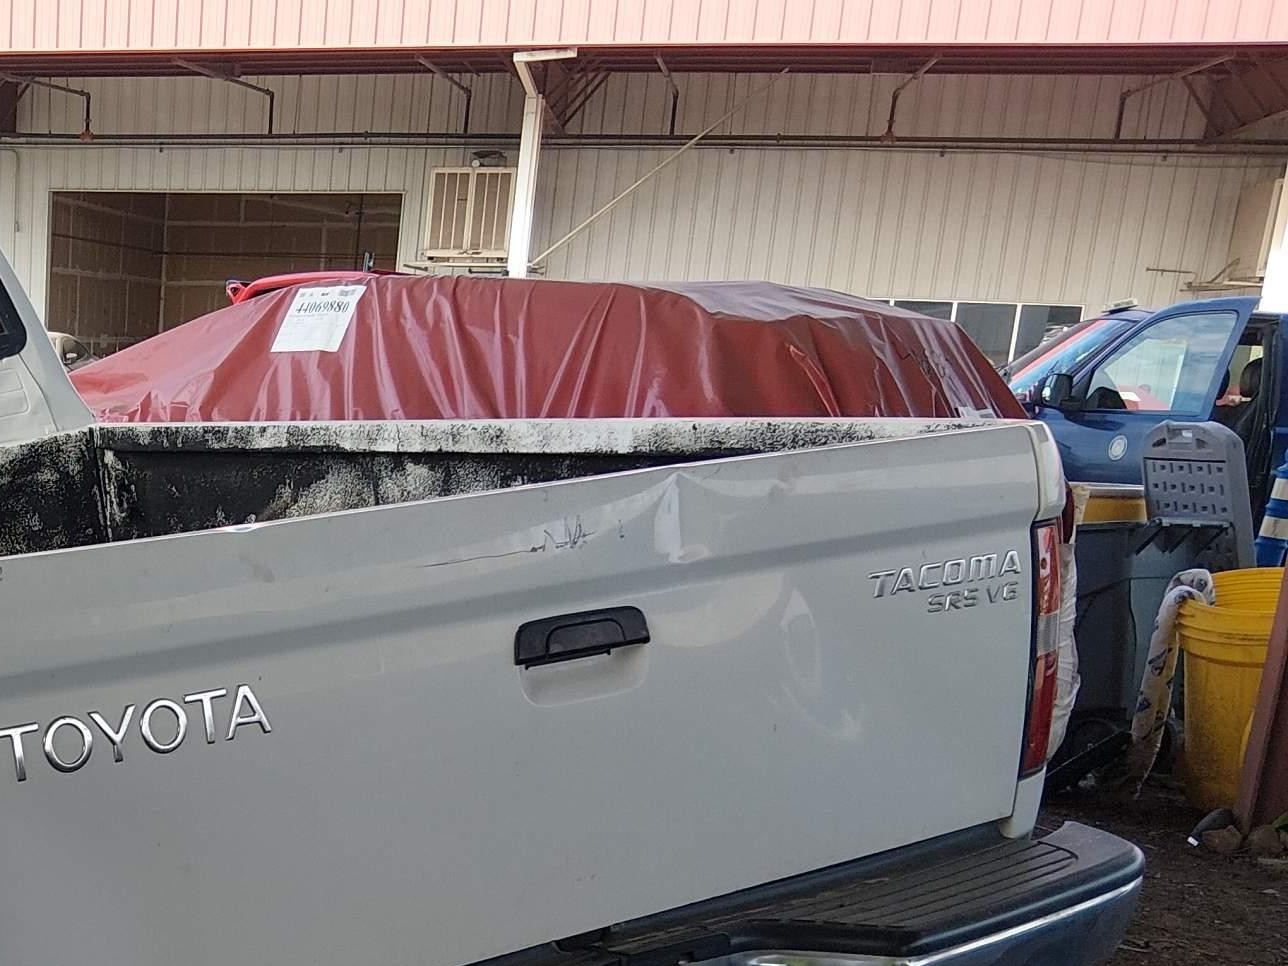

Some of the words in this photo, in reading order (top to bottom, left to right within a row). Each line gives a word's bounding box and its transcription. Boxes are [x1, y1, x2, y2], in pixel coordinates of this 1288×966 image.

[296, 300, 350, 313] 44069880
[868, 550, 1022, 598] TACOMA
[986, 581, 1019, 604] V6
